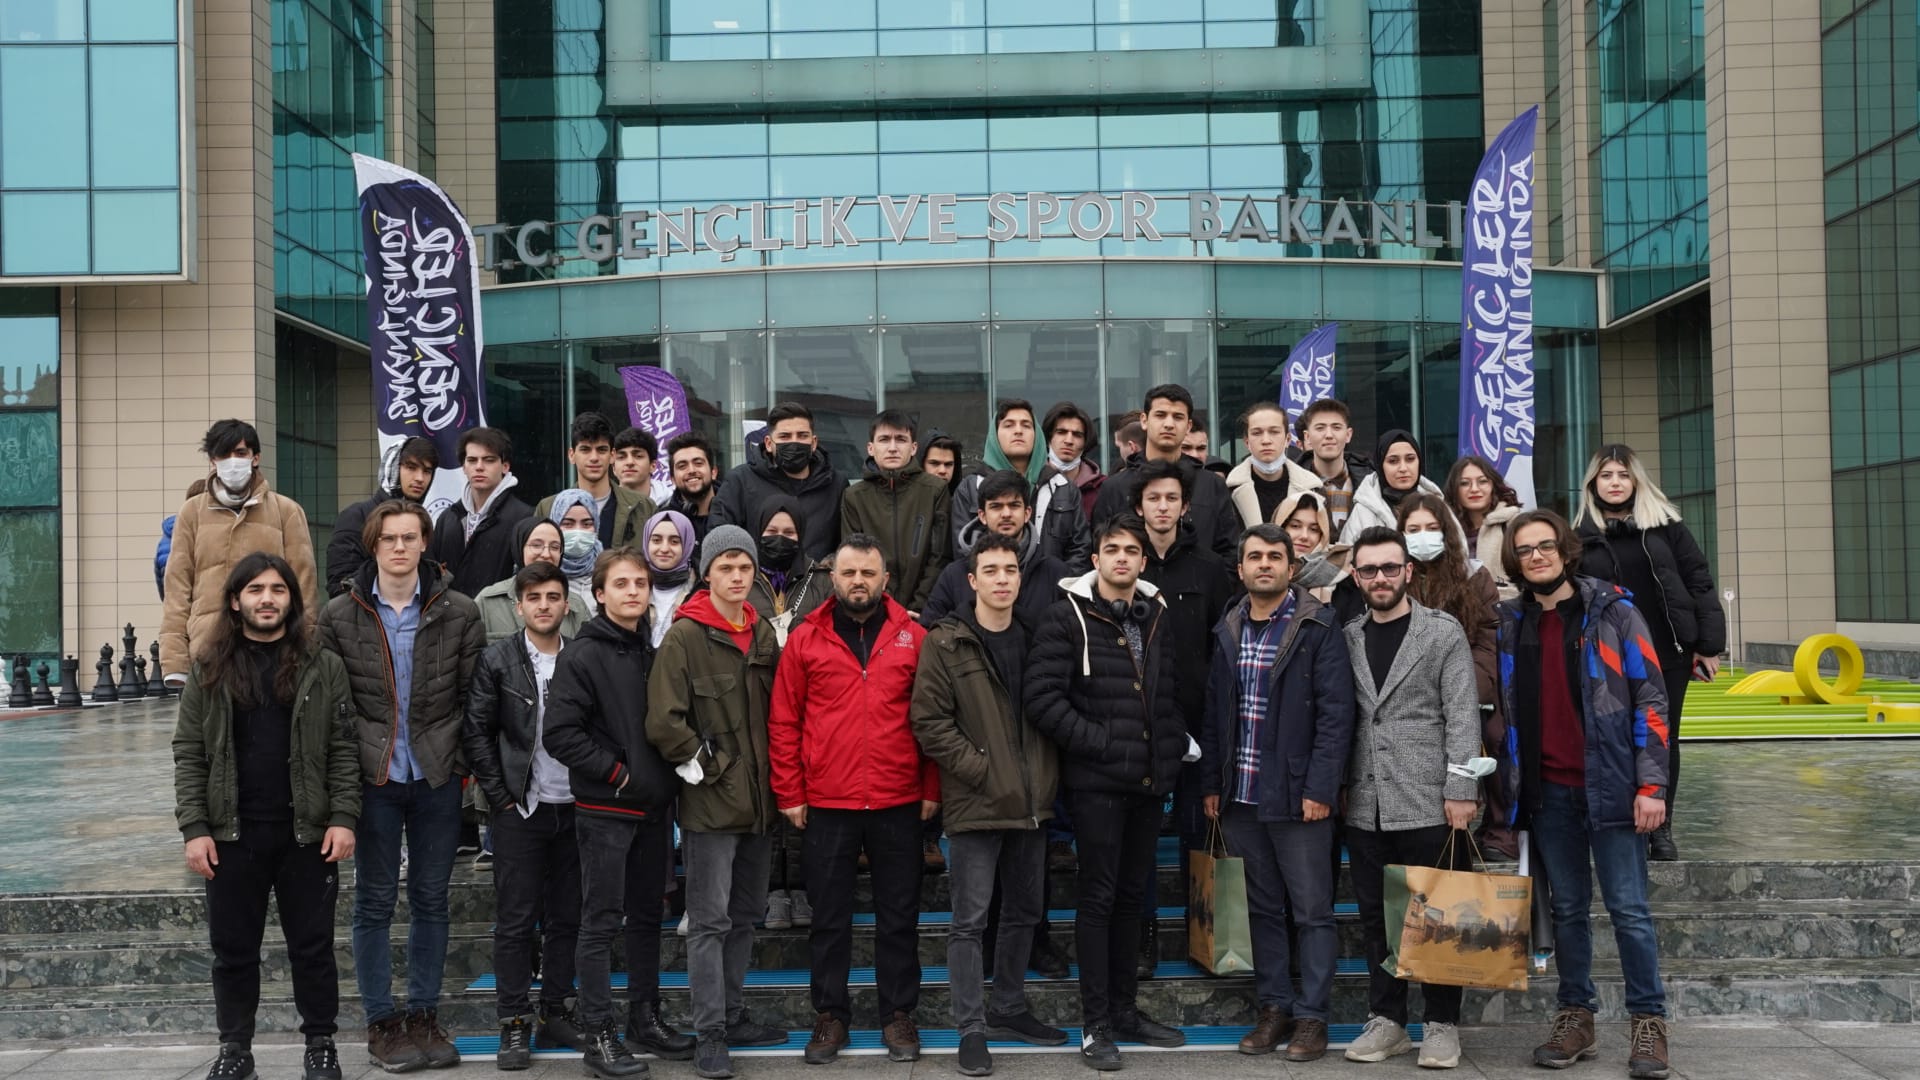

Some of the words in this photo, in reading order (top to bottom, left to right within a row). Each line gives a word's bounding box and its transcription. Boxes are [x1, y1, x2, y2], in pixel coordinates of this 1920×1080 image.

[472, 219, 564, 272] T.C.
[877, 193, 958, 246] VE
[987, 191, 1163, 242] SPOR
[1189, 191, 1463, 249] BAKANLI
[1471, 148, 1511, 463] GENÇLER
